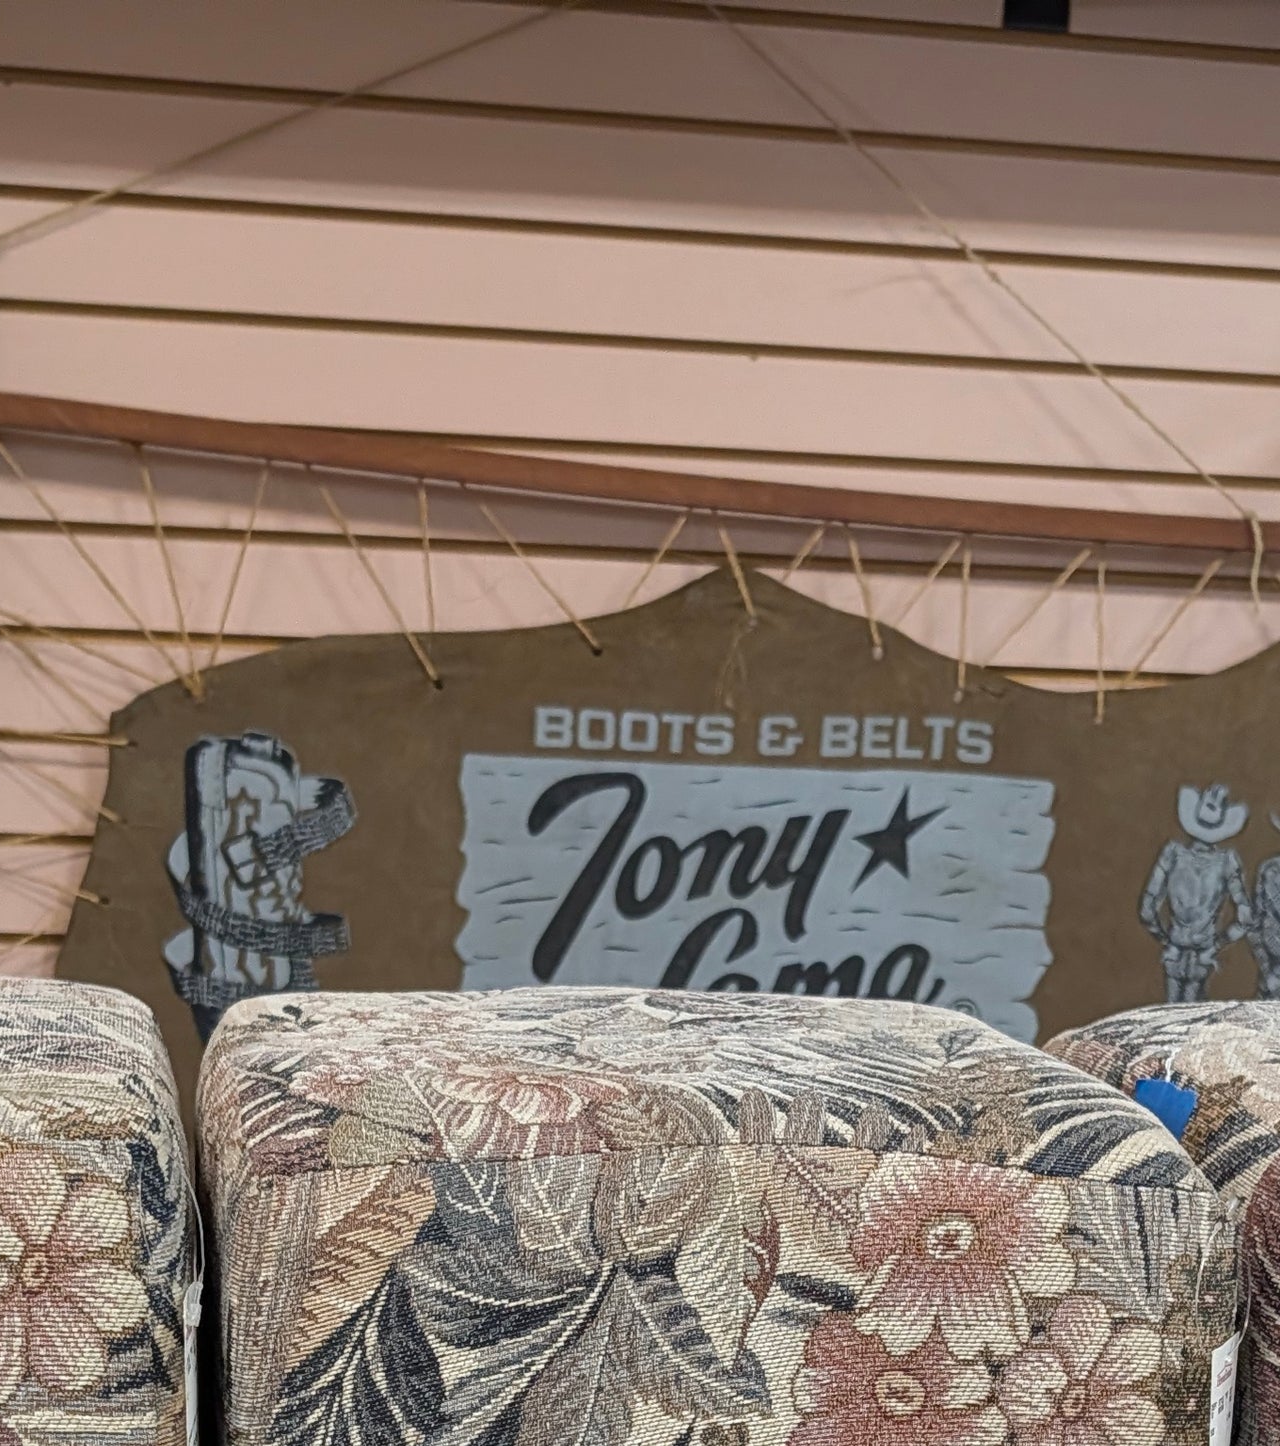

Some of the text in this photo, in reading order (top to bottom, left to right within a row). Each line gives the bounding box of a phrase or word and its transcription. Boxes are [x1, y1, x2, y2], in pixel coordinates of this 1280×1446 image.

[536, 706, 995, 765] BOOTS & BELTS
[528, 771, 852, 984] Tony
